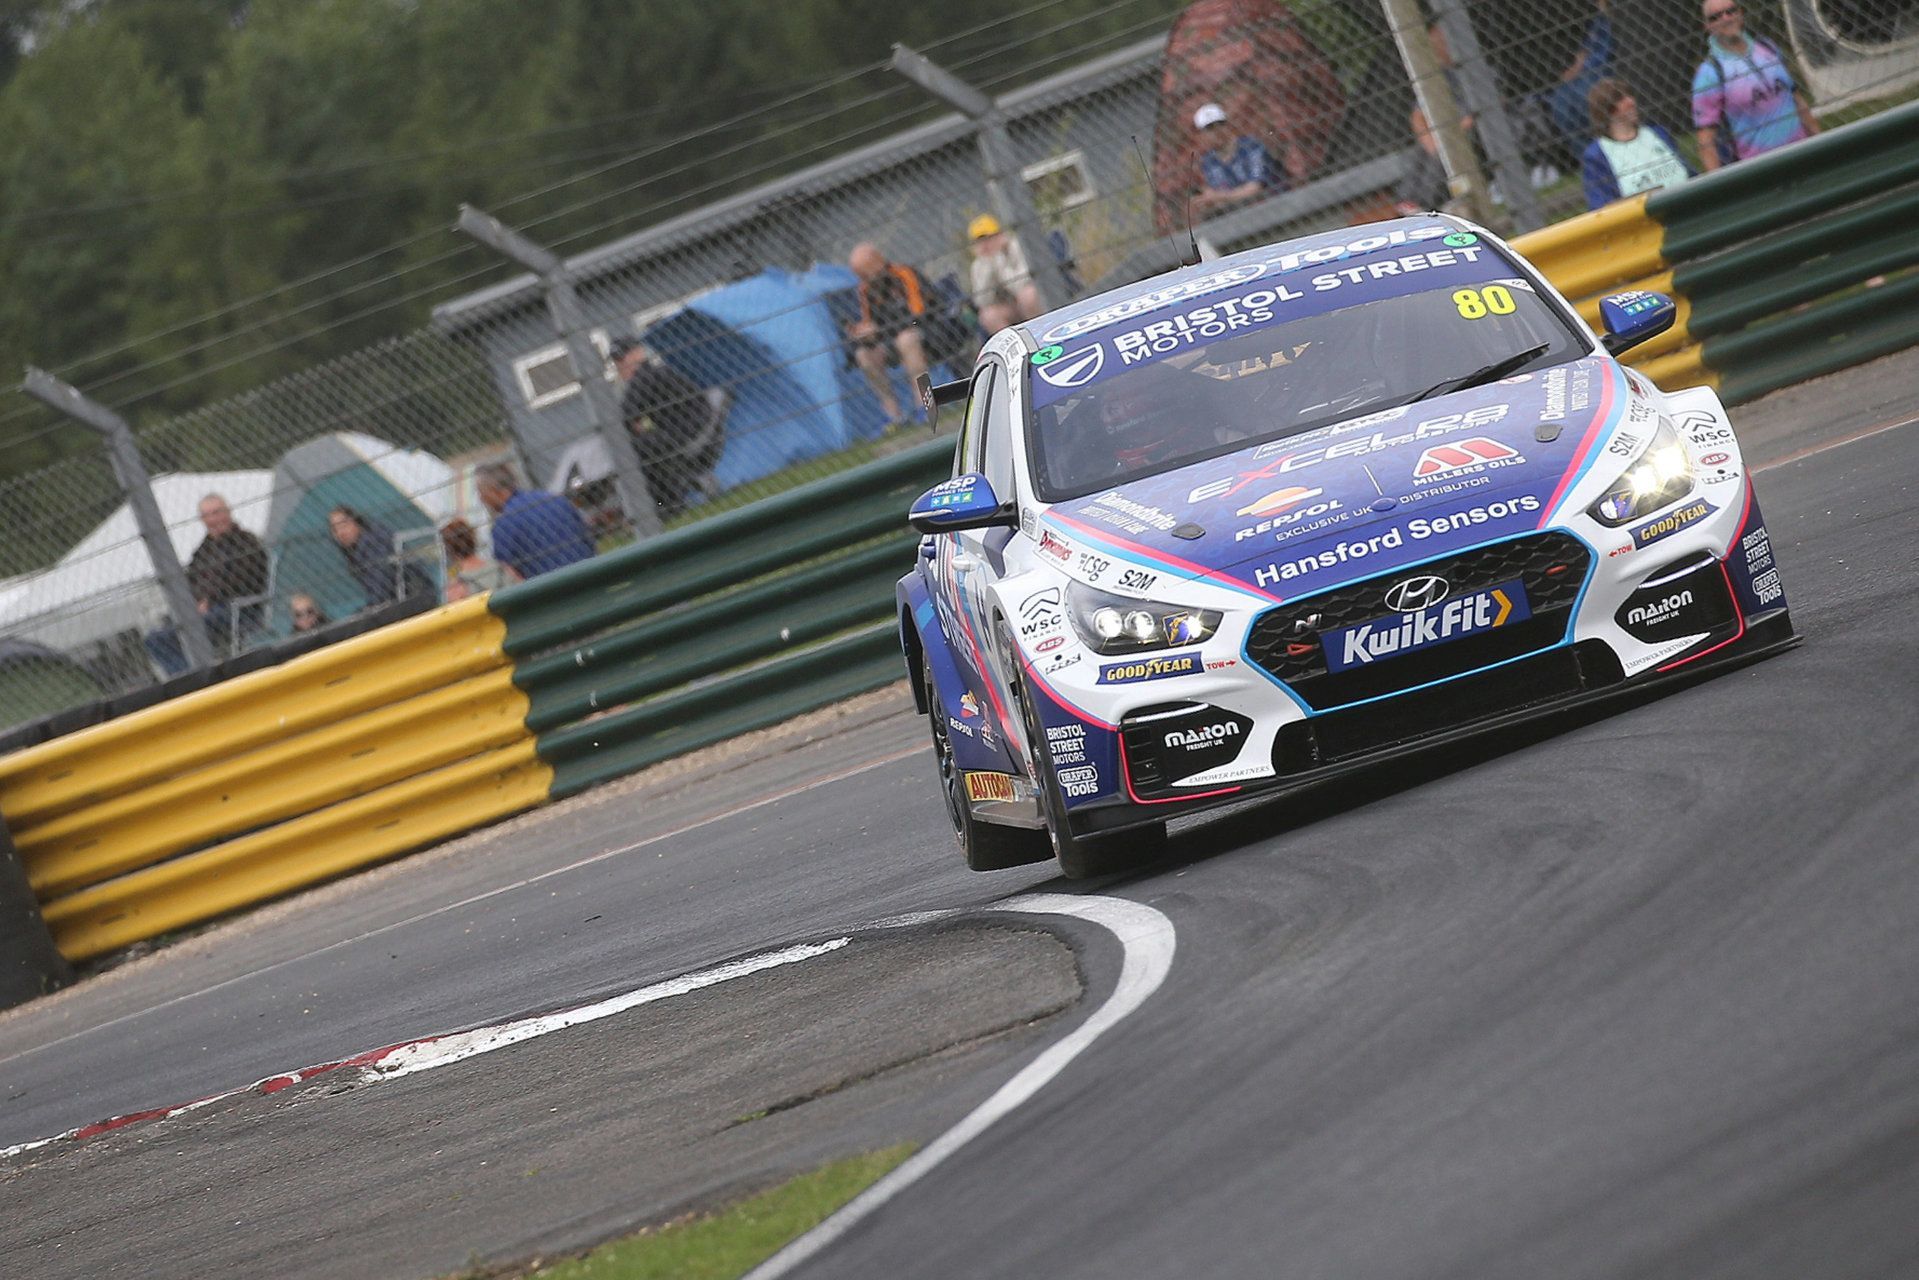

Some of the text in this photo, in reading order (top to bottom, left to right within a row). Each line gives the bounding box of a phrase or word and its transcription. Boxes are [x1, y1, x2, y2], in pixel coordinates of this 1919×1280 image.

[1062, 225, 1448, 333] DRAPER Tools
[1112, 246, 1482, 352] BRISTOL STREET
[1451, 285, 1517, 320] 80
[1119, 306, 1275, 365] MOTORS
[1353, 416, 1506, 457] MOTORSPORT
[1689, 429, 1731, 444] WSC
[1187, 403, 1511, 504] EXCELR8
[1412, 455, 1527, 487] MILLERS OILS
[933, 476, 977, 493] MSP
[1275, 475, 1492, 542] EXCLUSIVE UK DISTRIBUTOR
[1234, 499, 1345, 542] REPSOL
[1640, 503, 1708, 541] GOODYEAR
[1253, 493, 1541, 588] Hansford Sensors
[1742, 526, 1769, 550] BRISTOL
[1616, 544, 1633, 555] TOW
[1745, 541, 1771, 563] STREET
[1748, 554, 1772, 575] MOTORS
[1118, 569, 1158, 591] S2M
[1759, 584, 1783, 605] Tools
[1021, 614, 1062, 636] WSC
[1646, 609, 1680, 626] FREIGHT UK
[1106, 656, 1193, 681] GOODYEAR
[1206, 661, 1226, 671] TOW
[1046, 723, 1086, 740] BRISTOL
[1050, 738, 1086, 754] STREET
[1186, 740, 1213, 751] FREIGHT
[1052, 751, 1086, 765] MOTORS
[1060, 769, 1095, 783] DRAPER
[1188, 765, 1271, 784] EMPOWER PARTNERS
[1065, 781, 1099, 797] Tools
